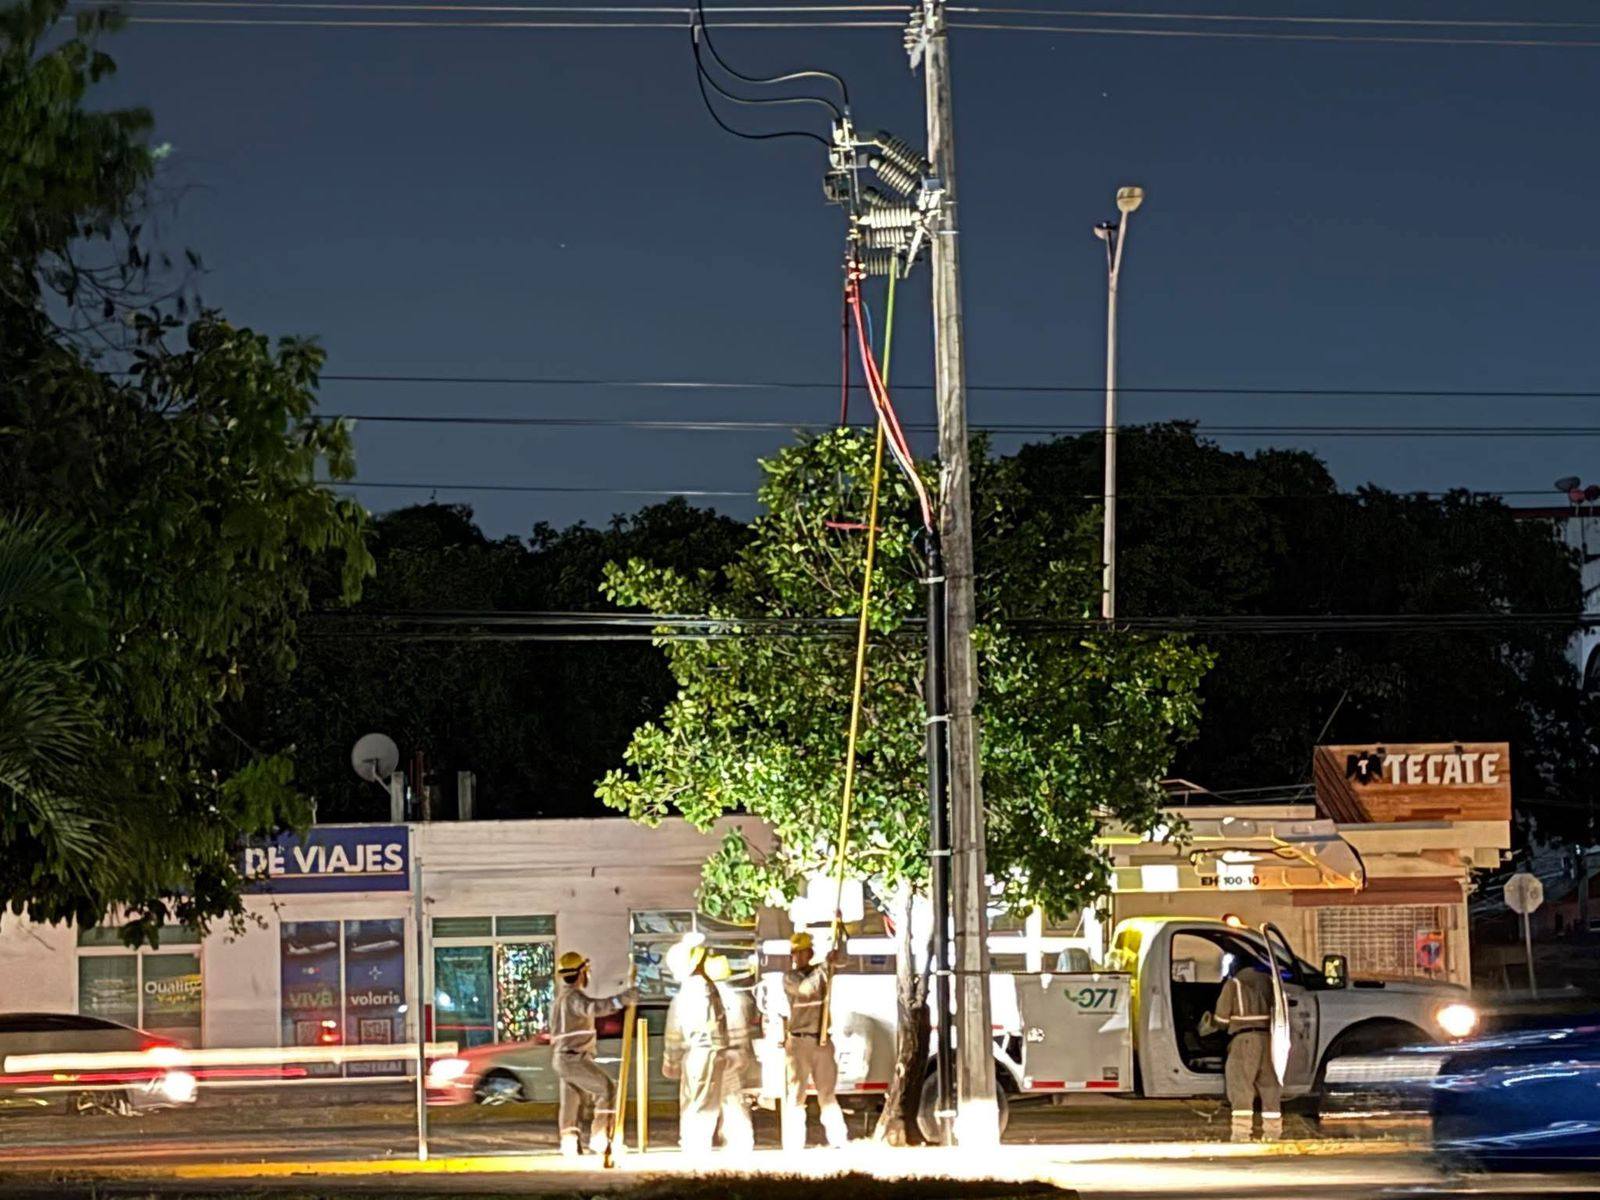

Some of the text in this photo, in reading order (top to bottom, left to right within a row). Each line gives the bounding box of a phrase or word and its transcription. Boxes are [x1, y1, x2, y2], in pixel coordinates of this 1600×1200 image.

[1383, 753, 1501, 785] TECATE
[244, 843, 404, 875] DE VIAJES
[145, 979, 199, 995] Quality
[1078, 987, 1119, 1009] 071
[350, 991, 401, 1006] volaris
